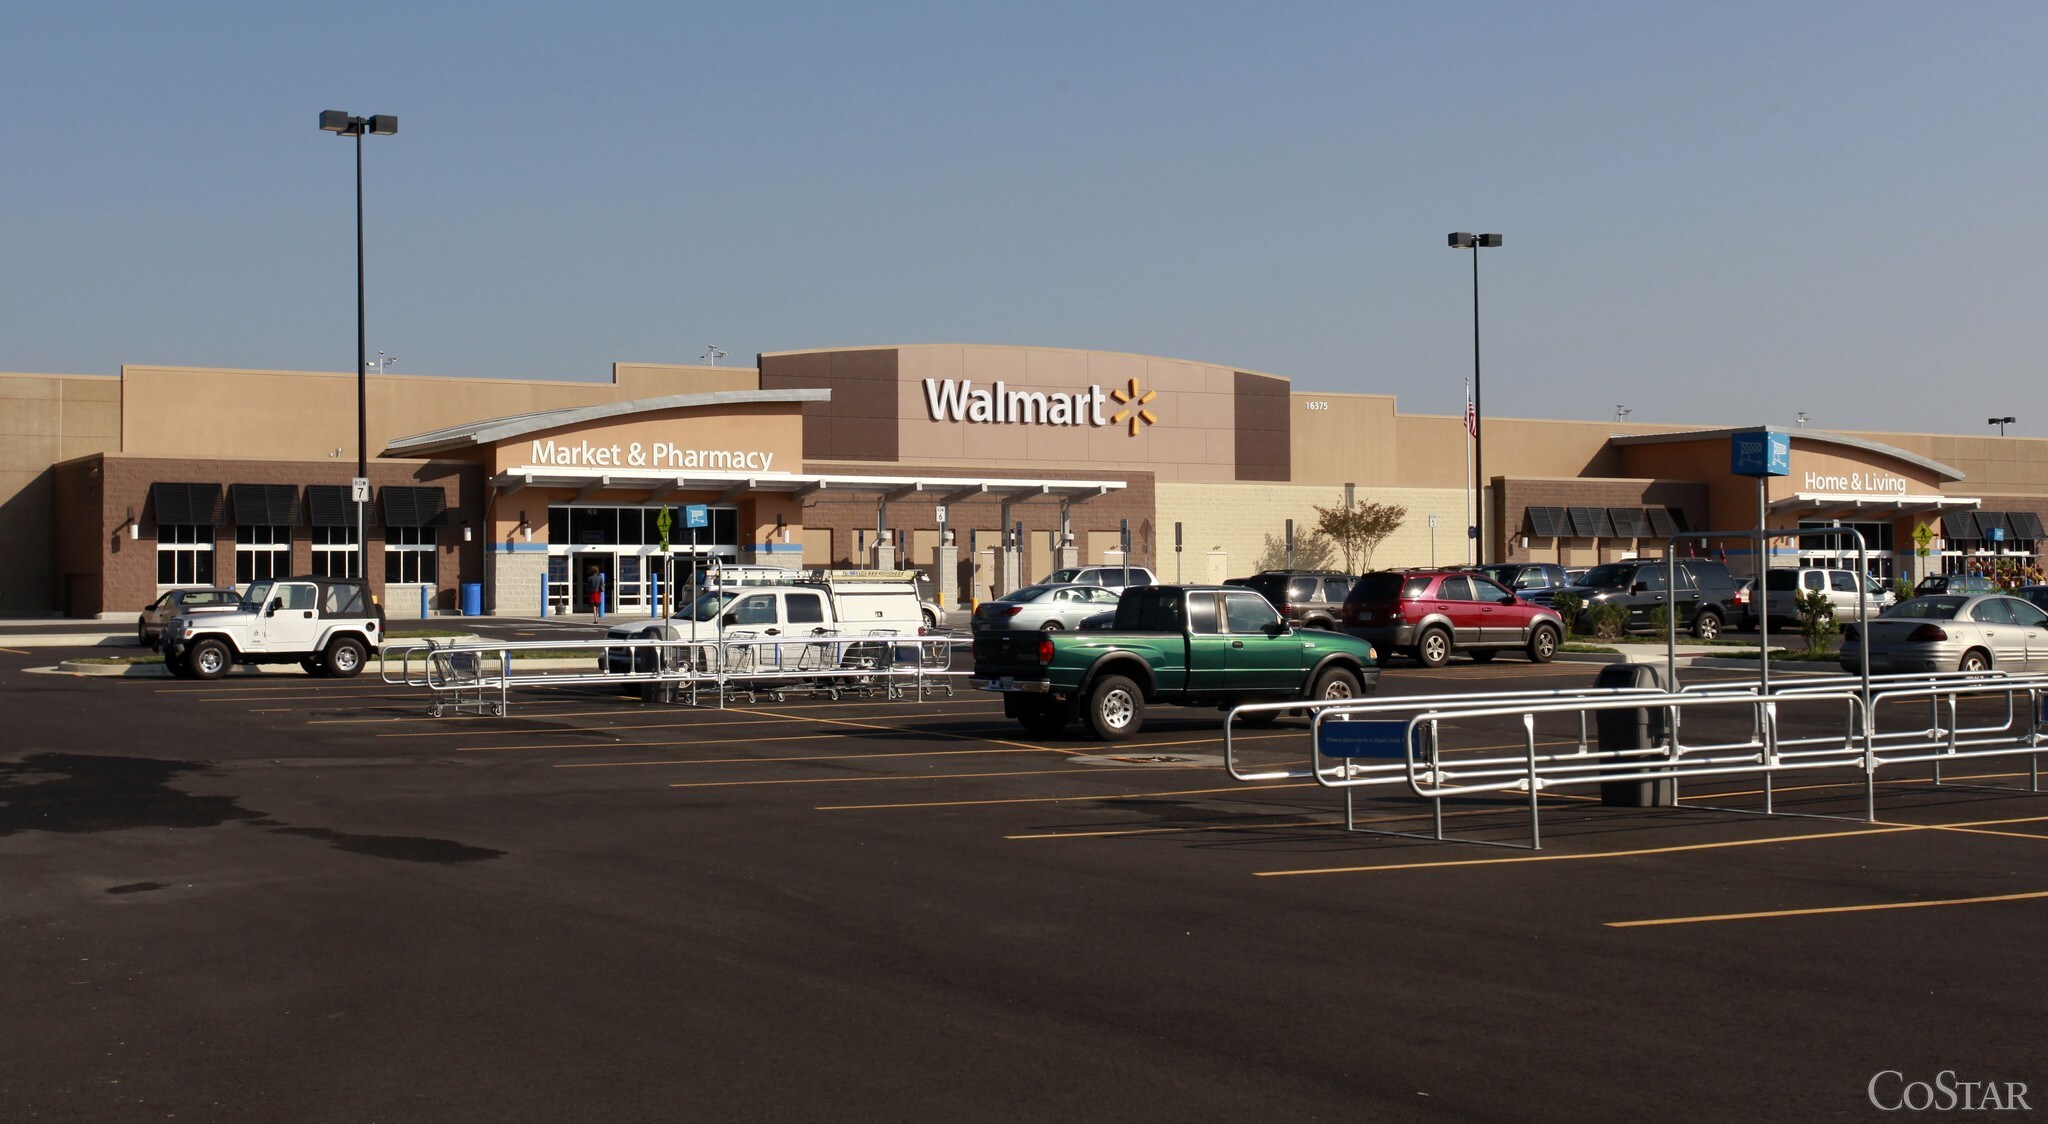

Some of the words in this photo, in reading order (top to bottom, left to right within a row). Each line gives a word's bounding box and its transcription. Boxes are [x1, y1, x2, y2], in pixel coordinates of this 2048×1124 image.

[924, 378, 1106, 426] Walmart
[1305, 401, 1328, 410] 16375
[531, 440, 621, 466] Market
[627, 442, 647, 466] &
[653, 442, 773, 472] Pharmacy
[1805, 471, 1848, 490] Home
[1851, 472, 1862, 491] &
[1865, 473, 1906, 495] Living
[358, 487, 364, 499] 7
[938, 512, 943, 520] 6
